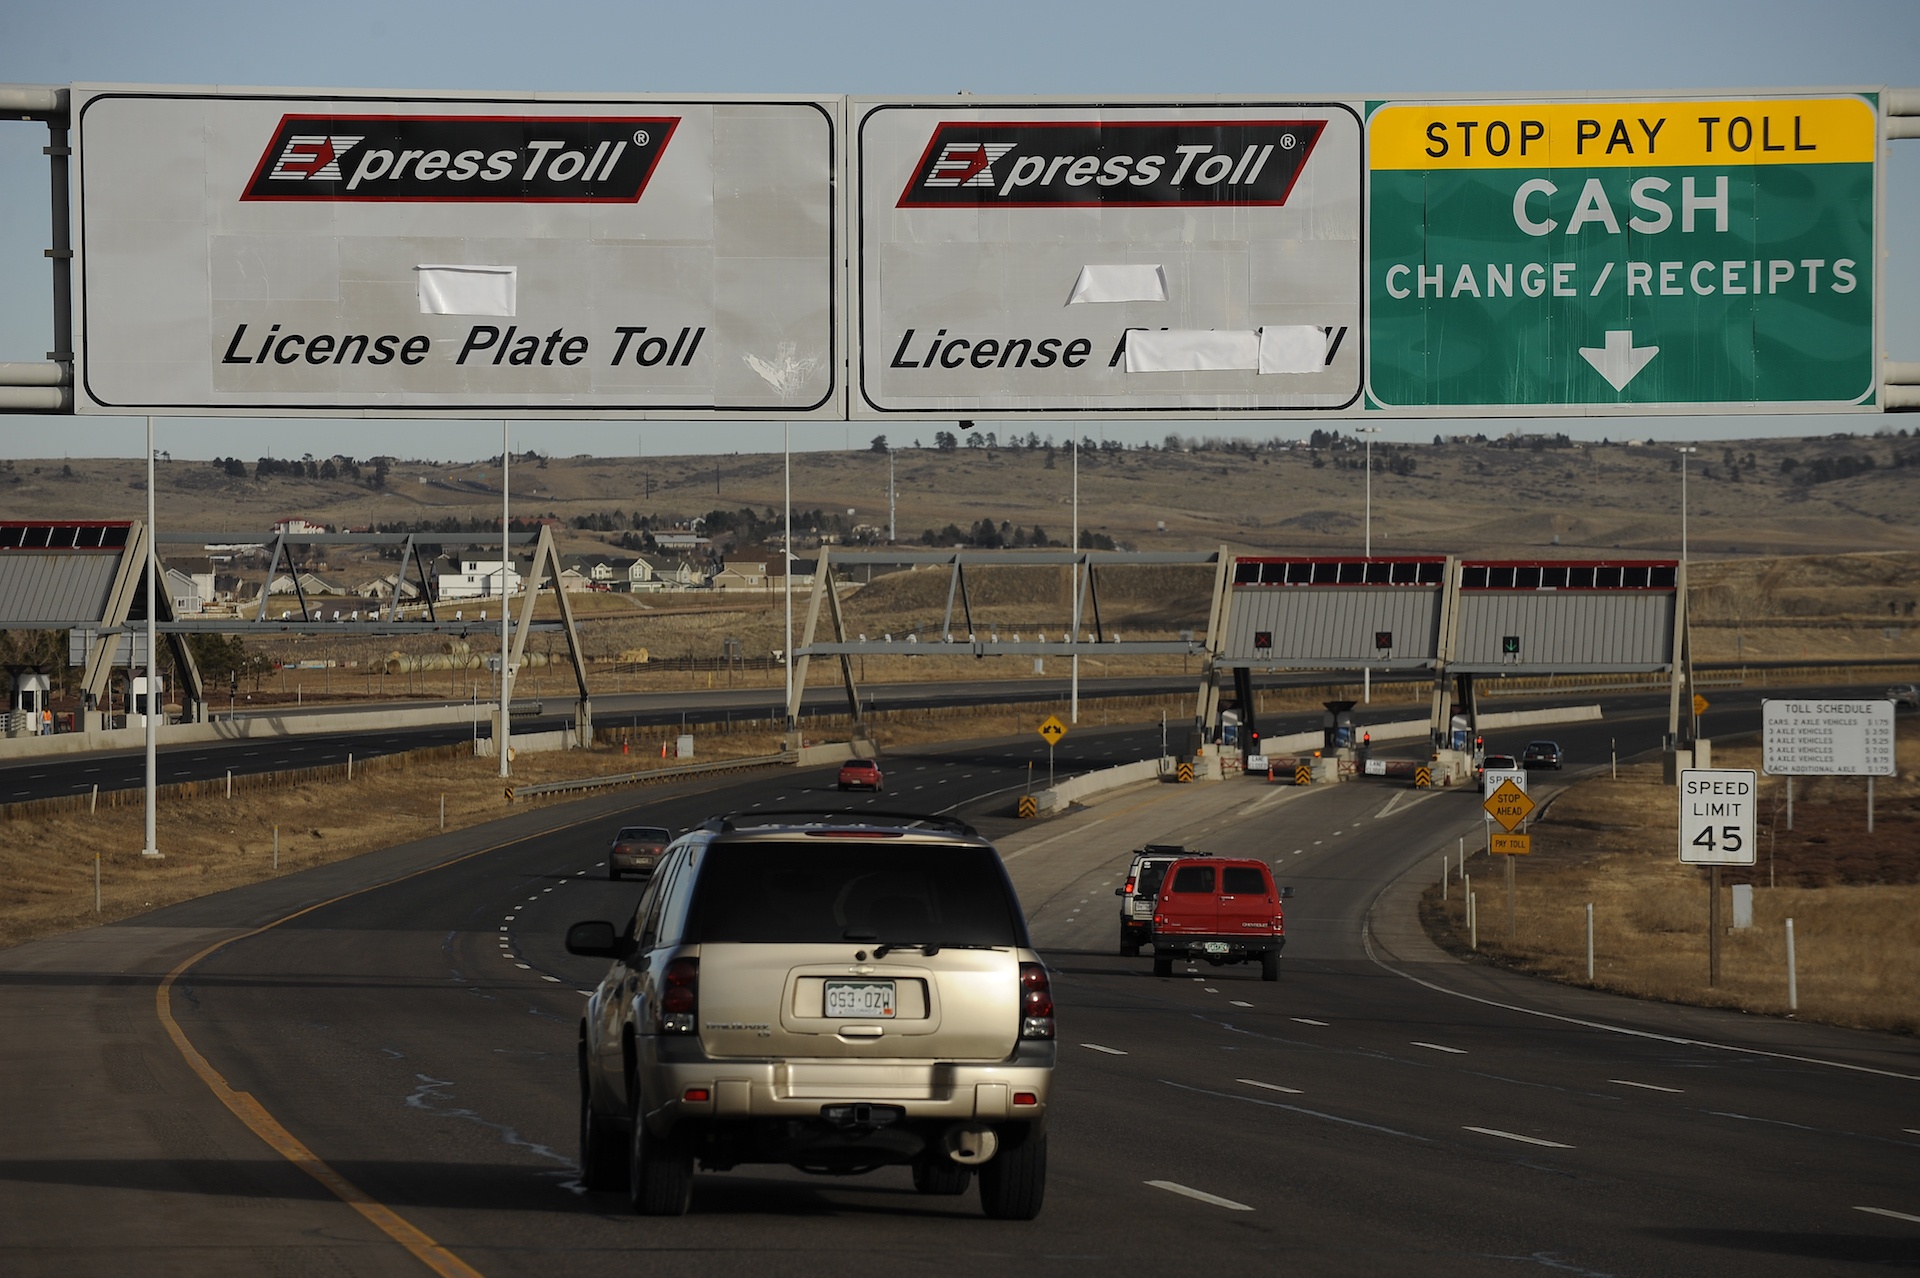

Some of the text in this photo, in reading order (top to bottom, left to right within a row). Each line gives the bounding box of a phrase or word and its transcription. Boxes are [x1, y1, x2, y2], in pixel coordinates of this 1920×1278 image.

[1425, 115, 1817, 158] STOP PAY TOLL
[1512, 175, 1729, 237] CASH
[221, 323, 706, 367] License Plate Toll
[889, 328, 1092, 368] License
[1785, 704, 1872, 714] TOLL SCHEDULE
[1687, 781, 1749, 795] SPEED
[1497, 794, 1521, 803] STOP
[1496, 807, 1522, 816] AHEAD
[1693, 802, 1742, 817] LIMIT
[1495, 840, 1525, 848] PAY TOLL
[1692, 825, 1743, 852] 45
